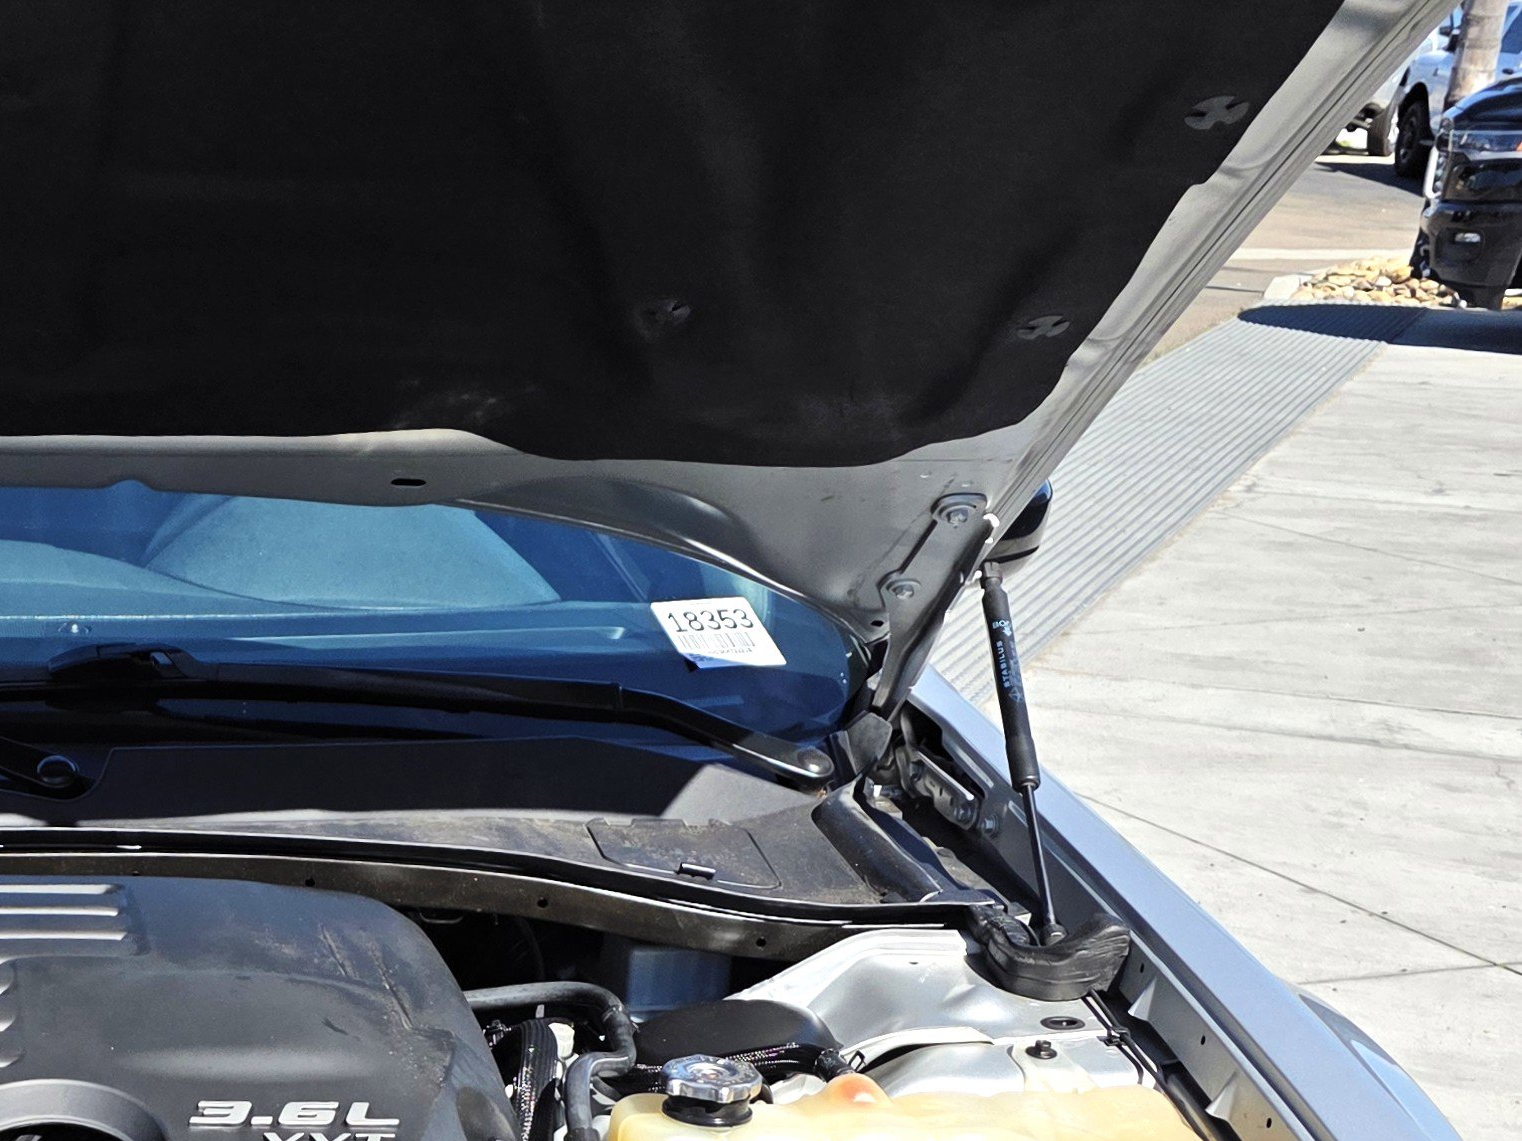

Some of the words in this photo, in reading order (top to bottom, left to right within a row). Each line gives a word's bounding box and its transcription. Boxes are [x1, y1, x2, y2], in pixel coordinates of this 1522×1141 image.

[667, 608, 754, 633] 18353
[996, 640, 1010, 688] STABILUS
[188, 1100, 401, 1127] 3.6L
